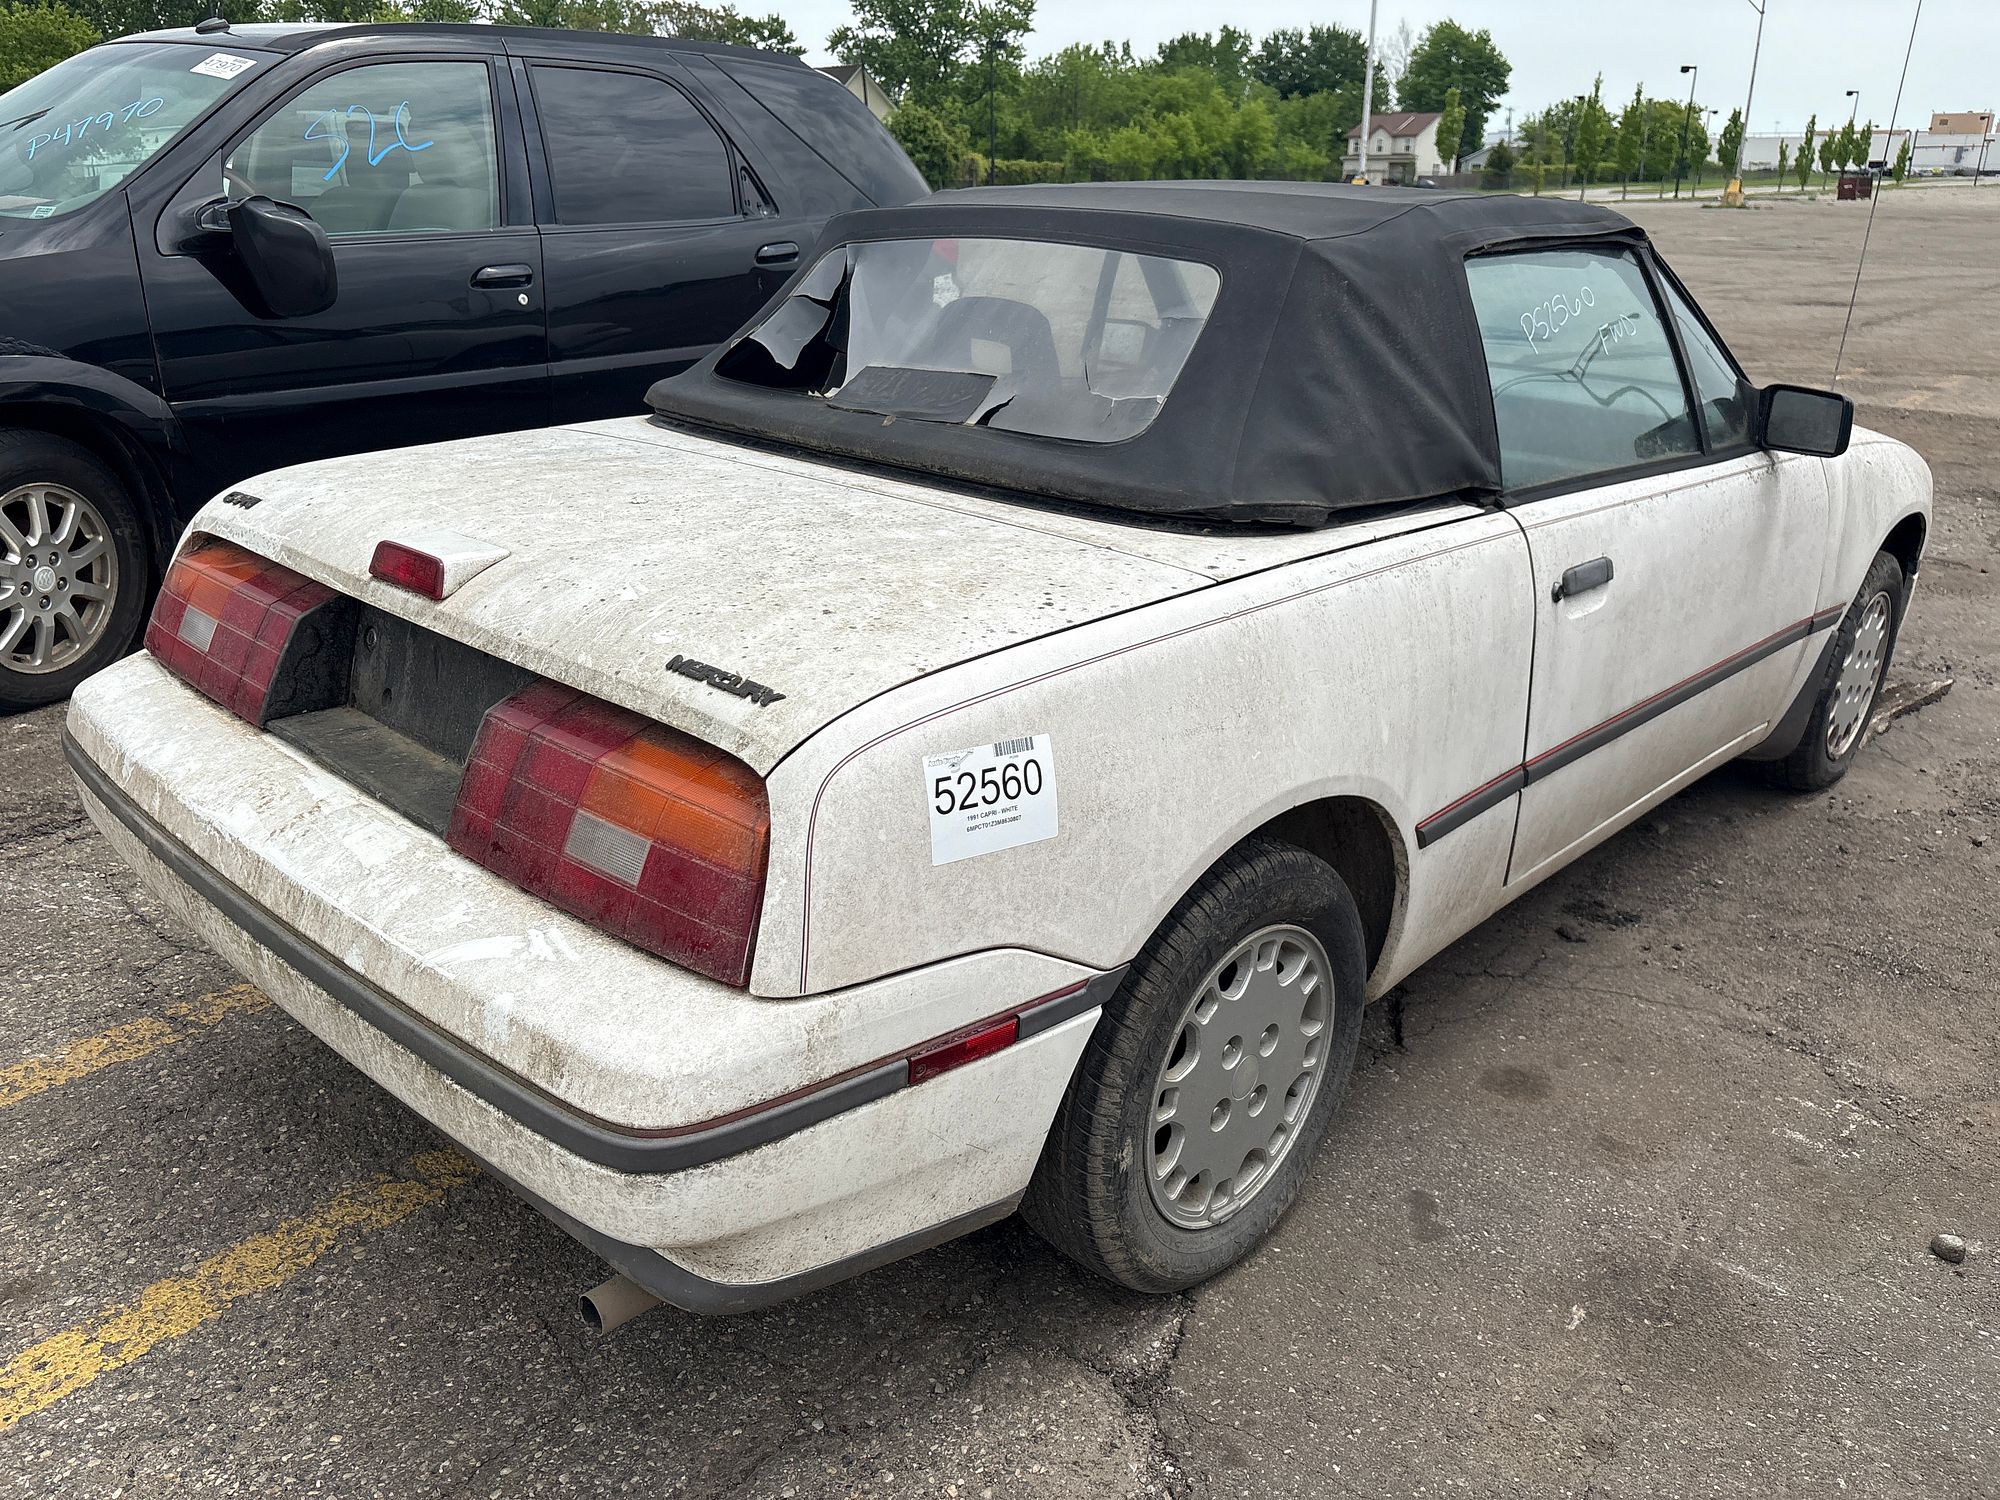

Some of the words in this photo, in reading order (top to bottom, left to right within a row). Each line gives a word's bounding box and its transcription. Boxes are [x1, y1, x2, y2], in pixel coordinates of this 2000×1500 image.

[27, 97, 164, 160] P47970
[665, 654, 787, 708] MERCURY
[935, 759, 1043, 815] 52560
[967, 814, 980, 822] 1991
[980, 809, 998, 819] CAPRI
[1001, 805, 1019, 815] WHITE
